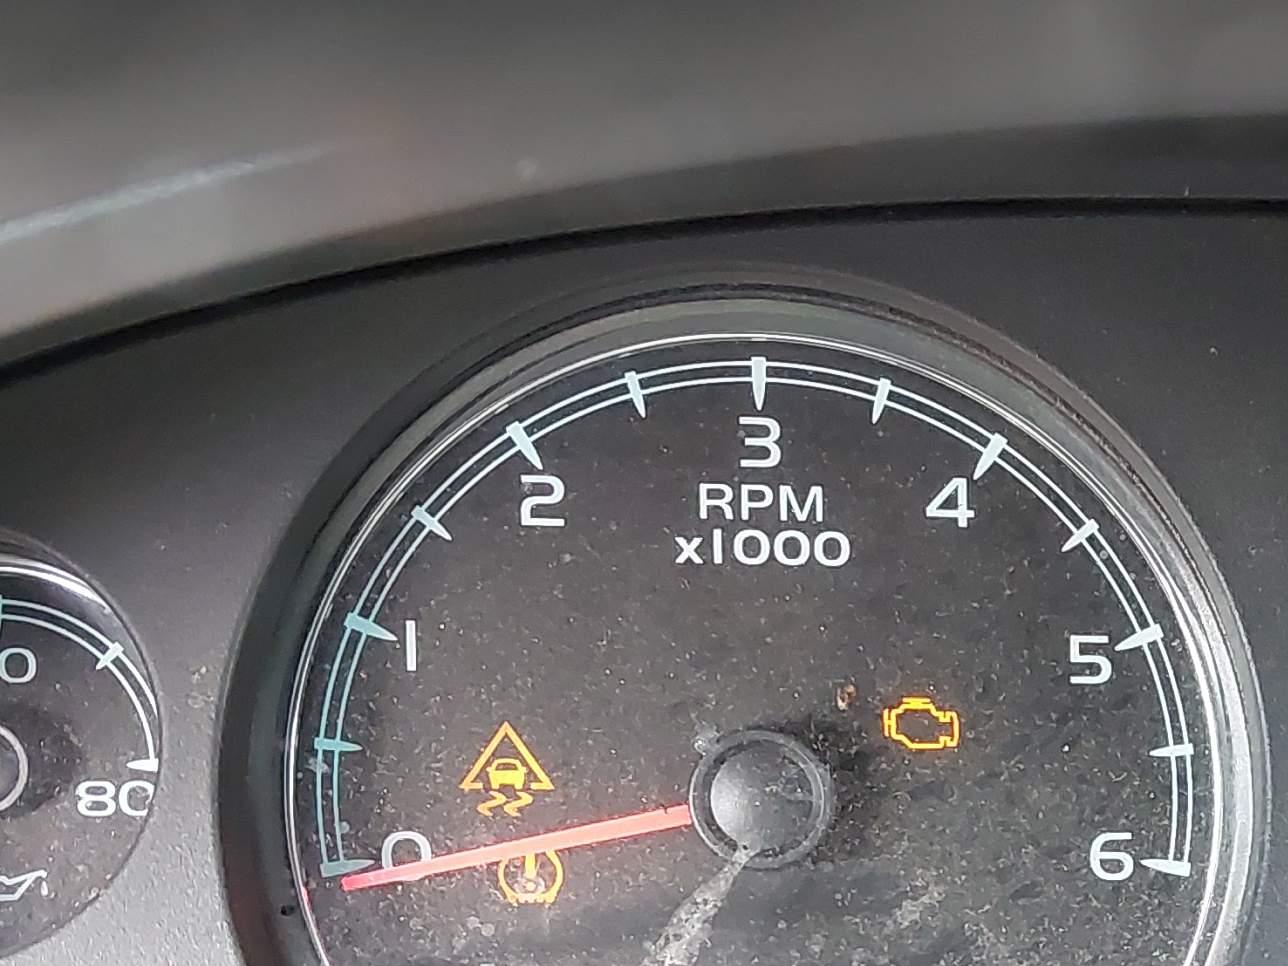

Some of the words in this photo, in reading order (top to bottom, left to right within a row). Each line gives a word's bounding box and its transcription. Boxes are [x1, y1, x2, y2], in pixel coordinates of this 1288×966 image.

[738, 416, 781, 468] 3
[520, 475, 565, 527] 2
[699, 483, 823, 522] RPM
[926, 477, 975, 528] 4
[675, 529, 851, 566] x1000
[405, 620, 416, 671] 1
[1069, 635, 1112, 684] 5
[76, 780, 155, 816] 80
[1090, 832, 1134, 881] 6
